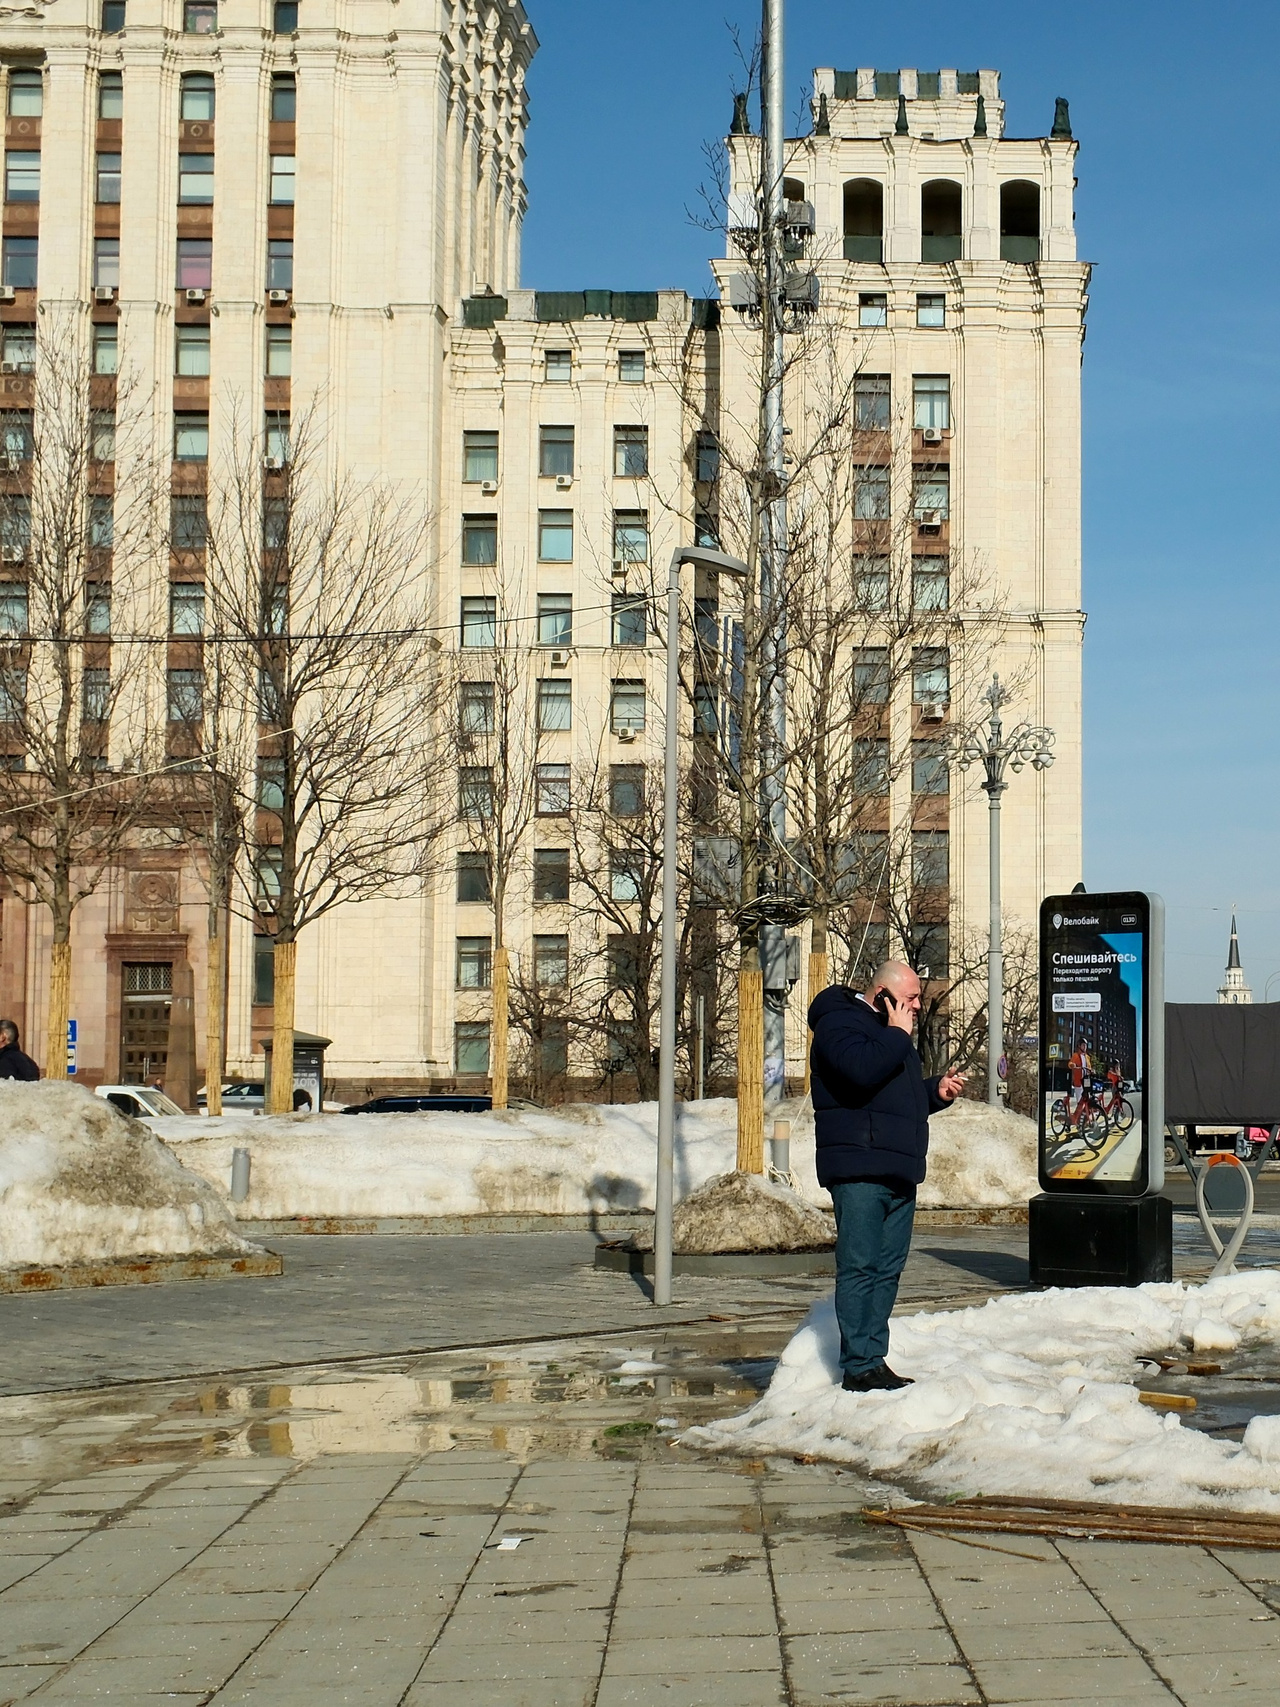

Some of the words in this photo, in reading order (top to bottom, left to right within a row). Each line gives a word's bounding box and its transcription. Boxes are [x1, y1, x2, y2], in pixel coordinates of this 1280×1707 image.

[1063, 916, 1100, 926] Велобайк
[1052, 951, 1137, 965] Спешивайтесь
[1053, 967, 1089, 975] Переходите
[1090, 967, 1113, 975] дорогу
